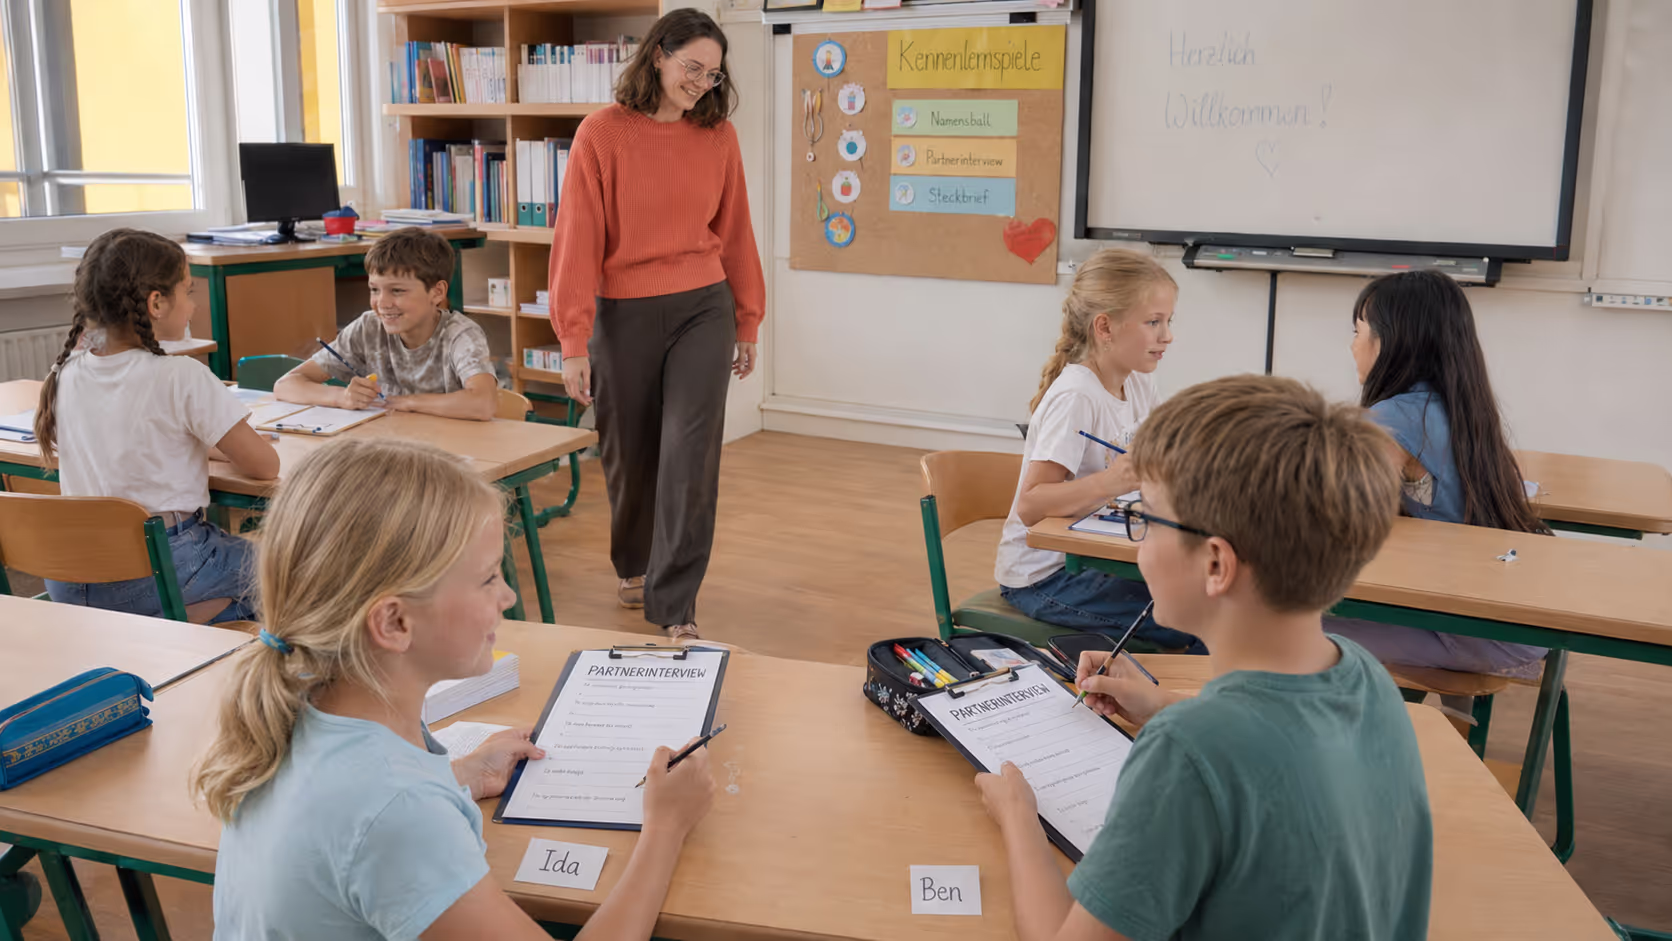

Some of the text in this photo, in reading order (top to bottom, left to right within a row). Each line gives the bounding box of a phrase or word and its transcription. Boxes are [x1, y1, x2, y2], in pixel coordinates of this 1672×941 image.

[1169, 29, 1256, 67] Herzlich
[930, 110, 992, 128] Namensball
[925, 149, 1004, 167] Partnerinterview
[928, 187, 990, 205] Steckbrief
[587, 664, 707, 679] PARTNERINTERVIEW
[949, 683, 1051, 721] PARTNERINTERVIEW
[538, 848, 581, 876] Ida
[919, 876, 963, 902] Ben
